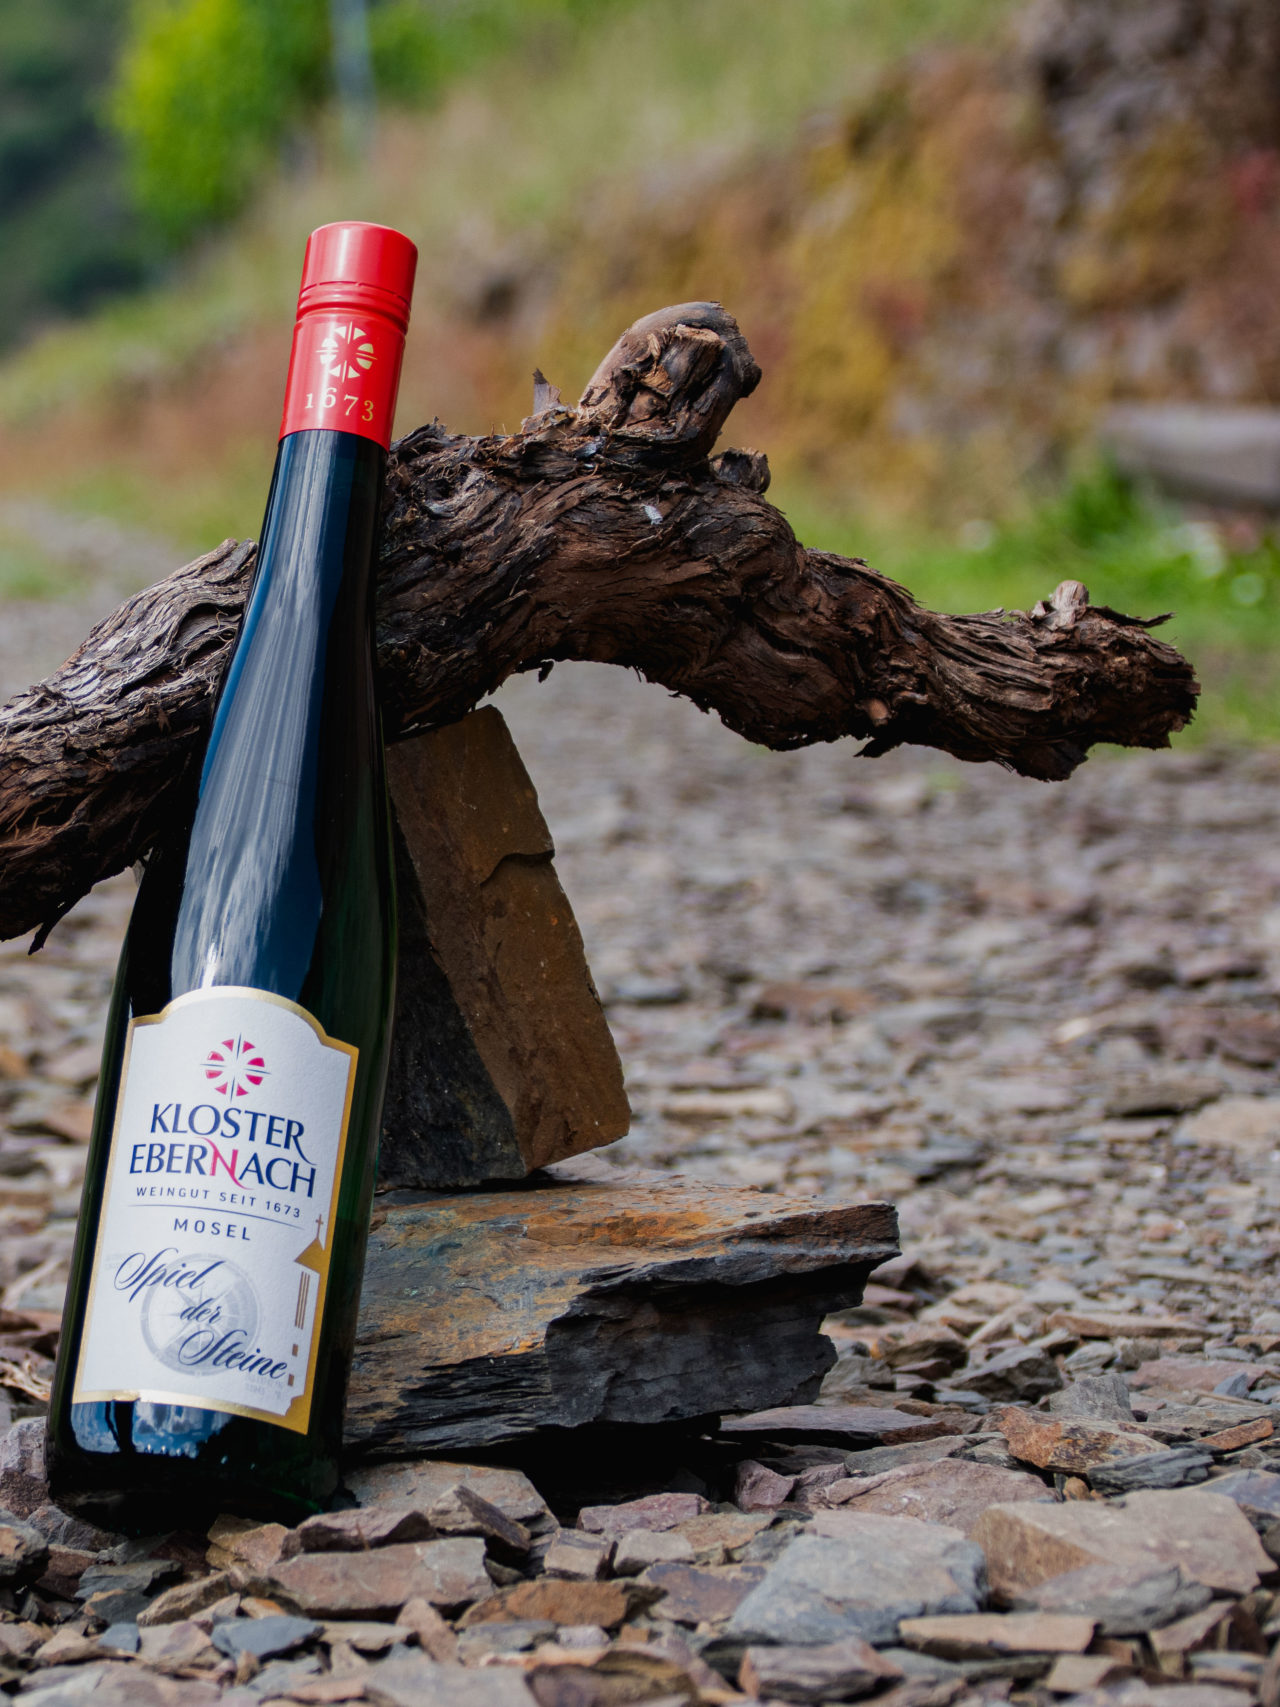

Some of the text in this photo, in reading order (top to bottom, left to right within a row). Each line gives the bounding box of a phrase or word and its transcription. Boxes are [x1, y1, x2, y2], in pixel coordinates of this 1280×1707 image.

[305, 387, 374, 422] 1673
[150, 1103, 318, 1166] KLOSTER
[128, 1137, 317, 1199] EBERNACH
[135, 1186, 301, 1218] WEINGUT SEIT 1673
[173, 1218, 251, 1241] MOSEL
[113, 1247, 226, 1303] Spiel
[179, 1297, 222, 1324] der
[178, 1329, 287, 1380] Steine
